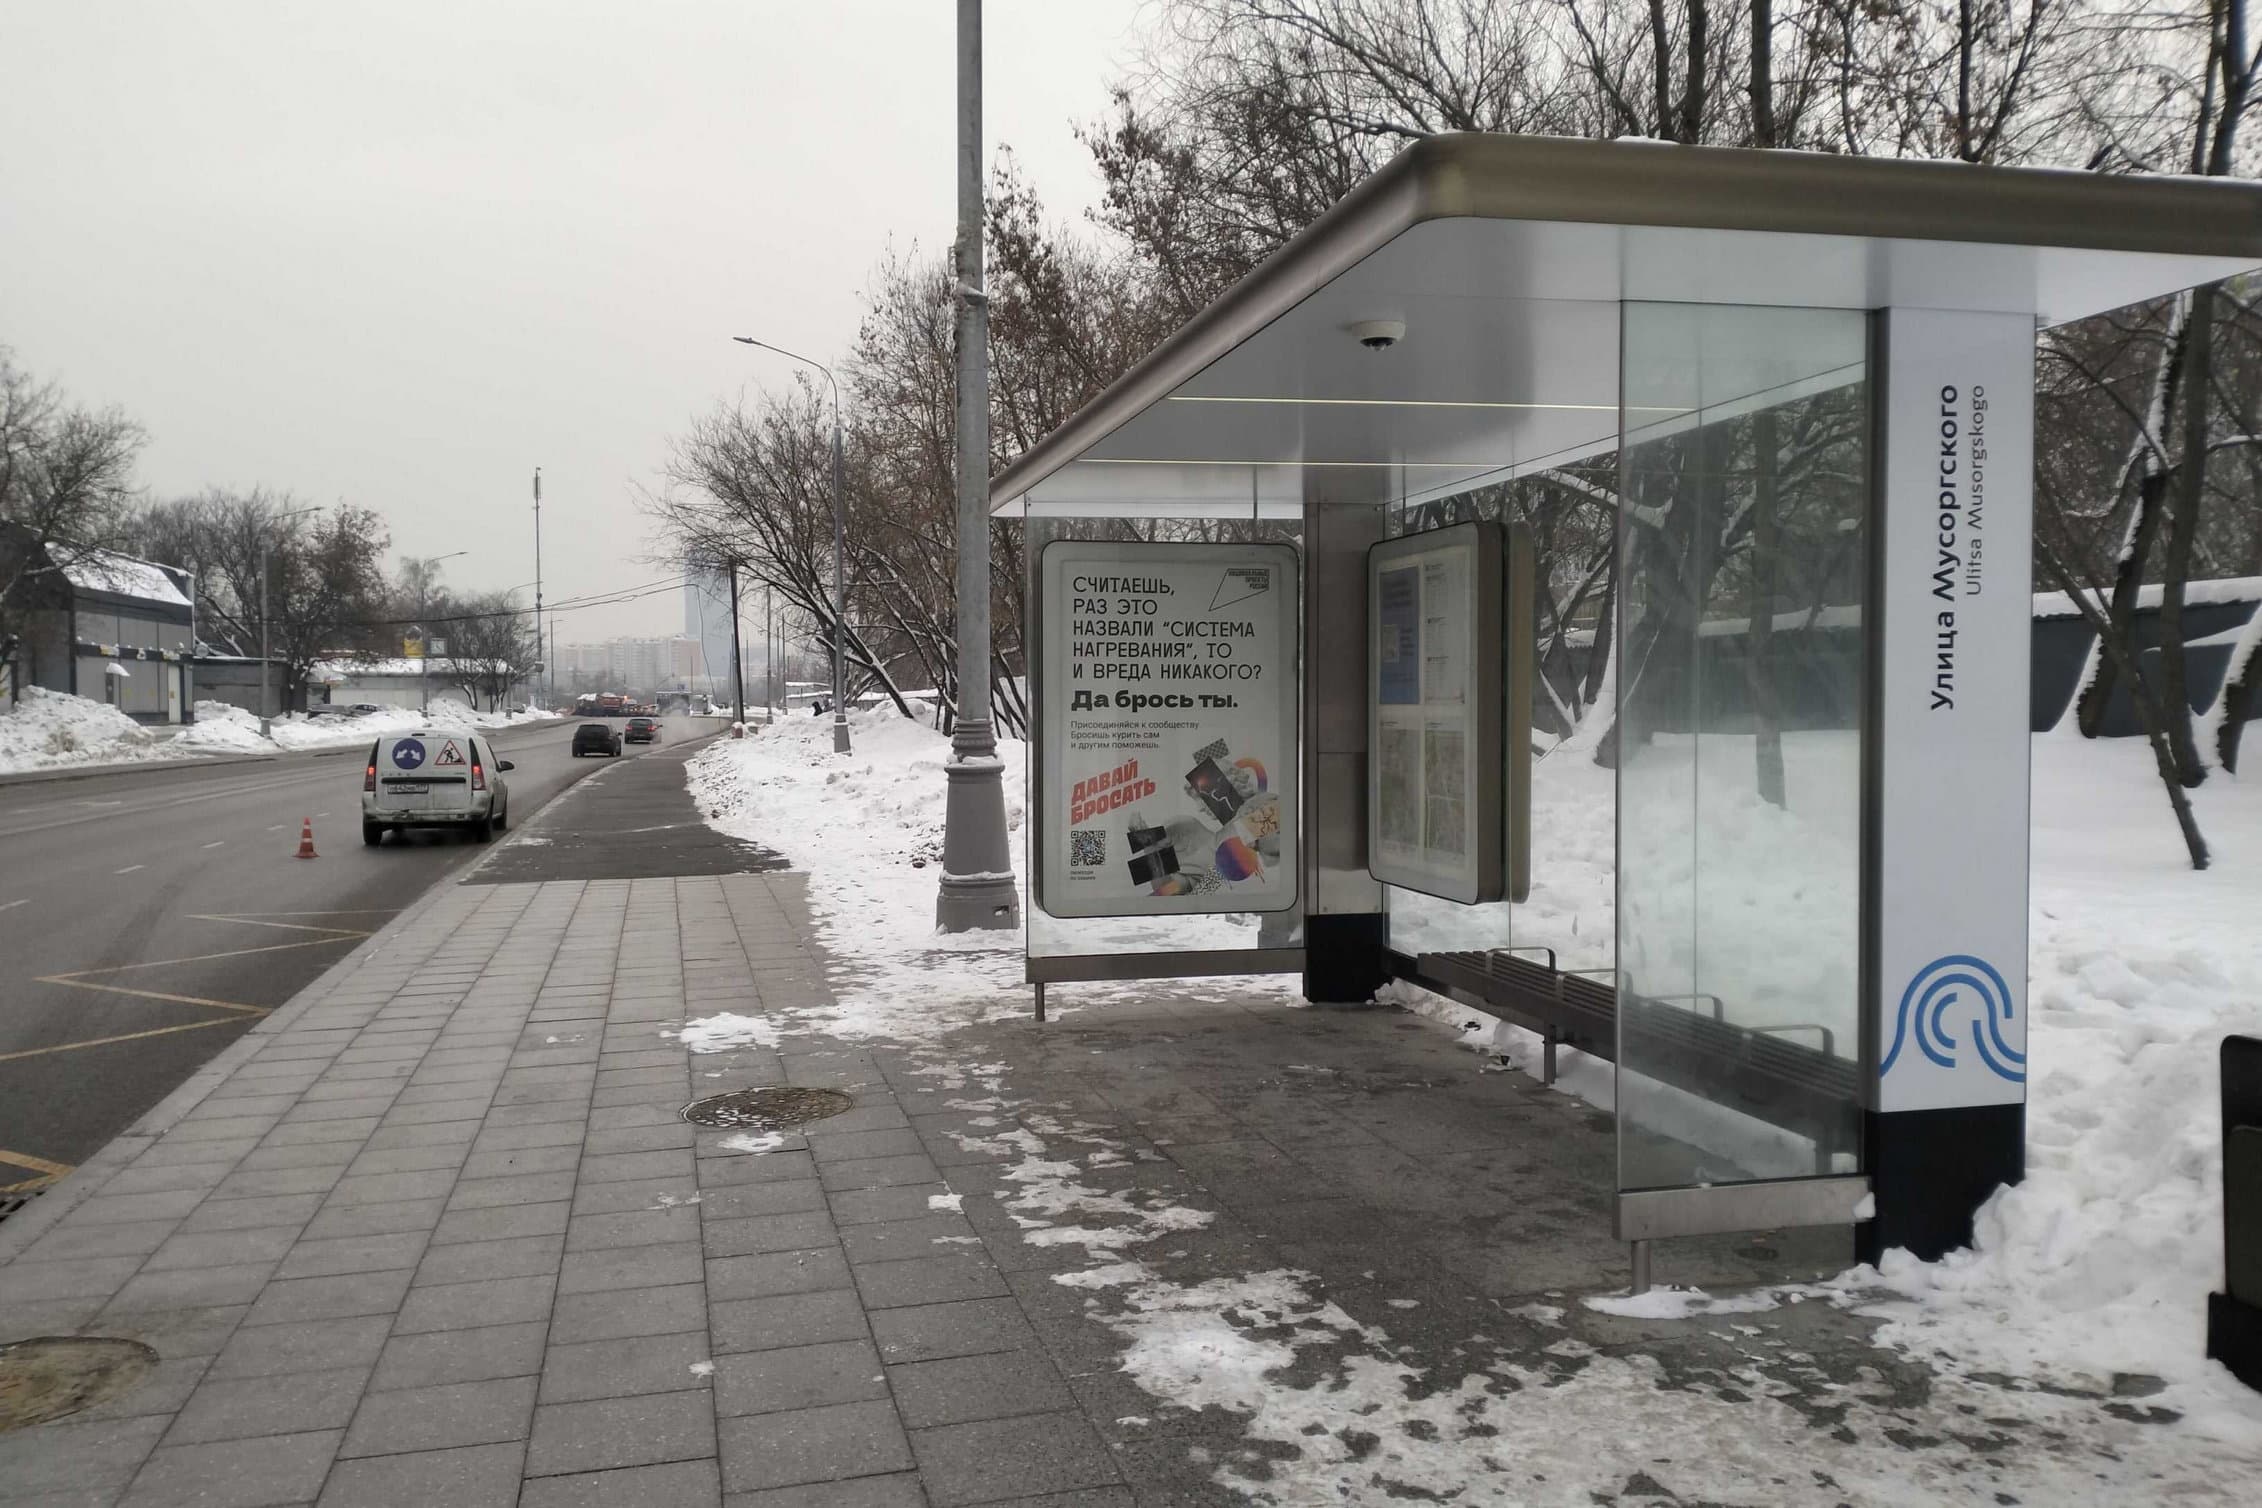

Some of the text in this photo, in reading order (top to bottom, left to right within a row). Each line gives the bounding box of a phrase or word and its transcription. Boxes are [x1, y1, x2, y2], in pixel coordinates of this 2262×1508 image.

[1966, 385, 1988, 595] Ulitsa Musorgskogo
[1931, 385, 1961, 710] Улица Мусоргского
[1073, 576, 1175, 596] СЧИТАЕШЬ,
[1073, 599, 1158, 615] РАЗ ЭТО
[1073, 620, 1154, 636] НАЗВАЛИ
[1206, 642, 1232, 658] ТО
[1073, 663, 1262, 682] И ВРЕДА НИКАКОГО?
[1071, 690, 1239, 713] Да брось ты.
[1070, 720, 1139, 730] Присоединяйся
[1148, 720, 1199, 730] сообществу
[1070, 731, 1110, 740] Бросишь
[1112, 732, 1142, 741] курить
[1078, 742, 1110, 750] другим
[1071, 757, 1138, 806] ДАВАЙ
[1071, 778, 1156, 826] БРОСАТЬ
